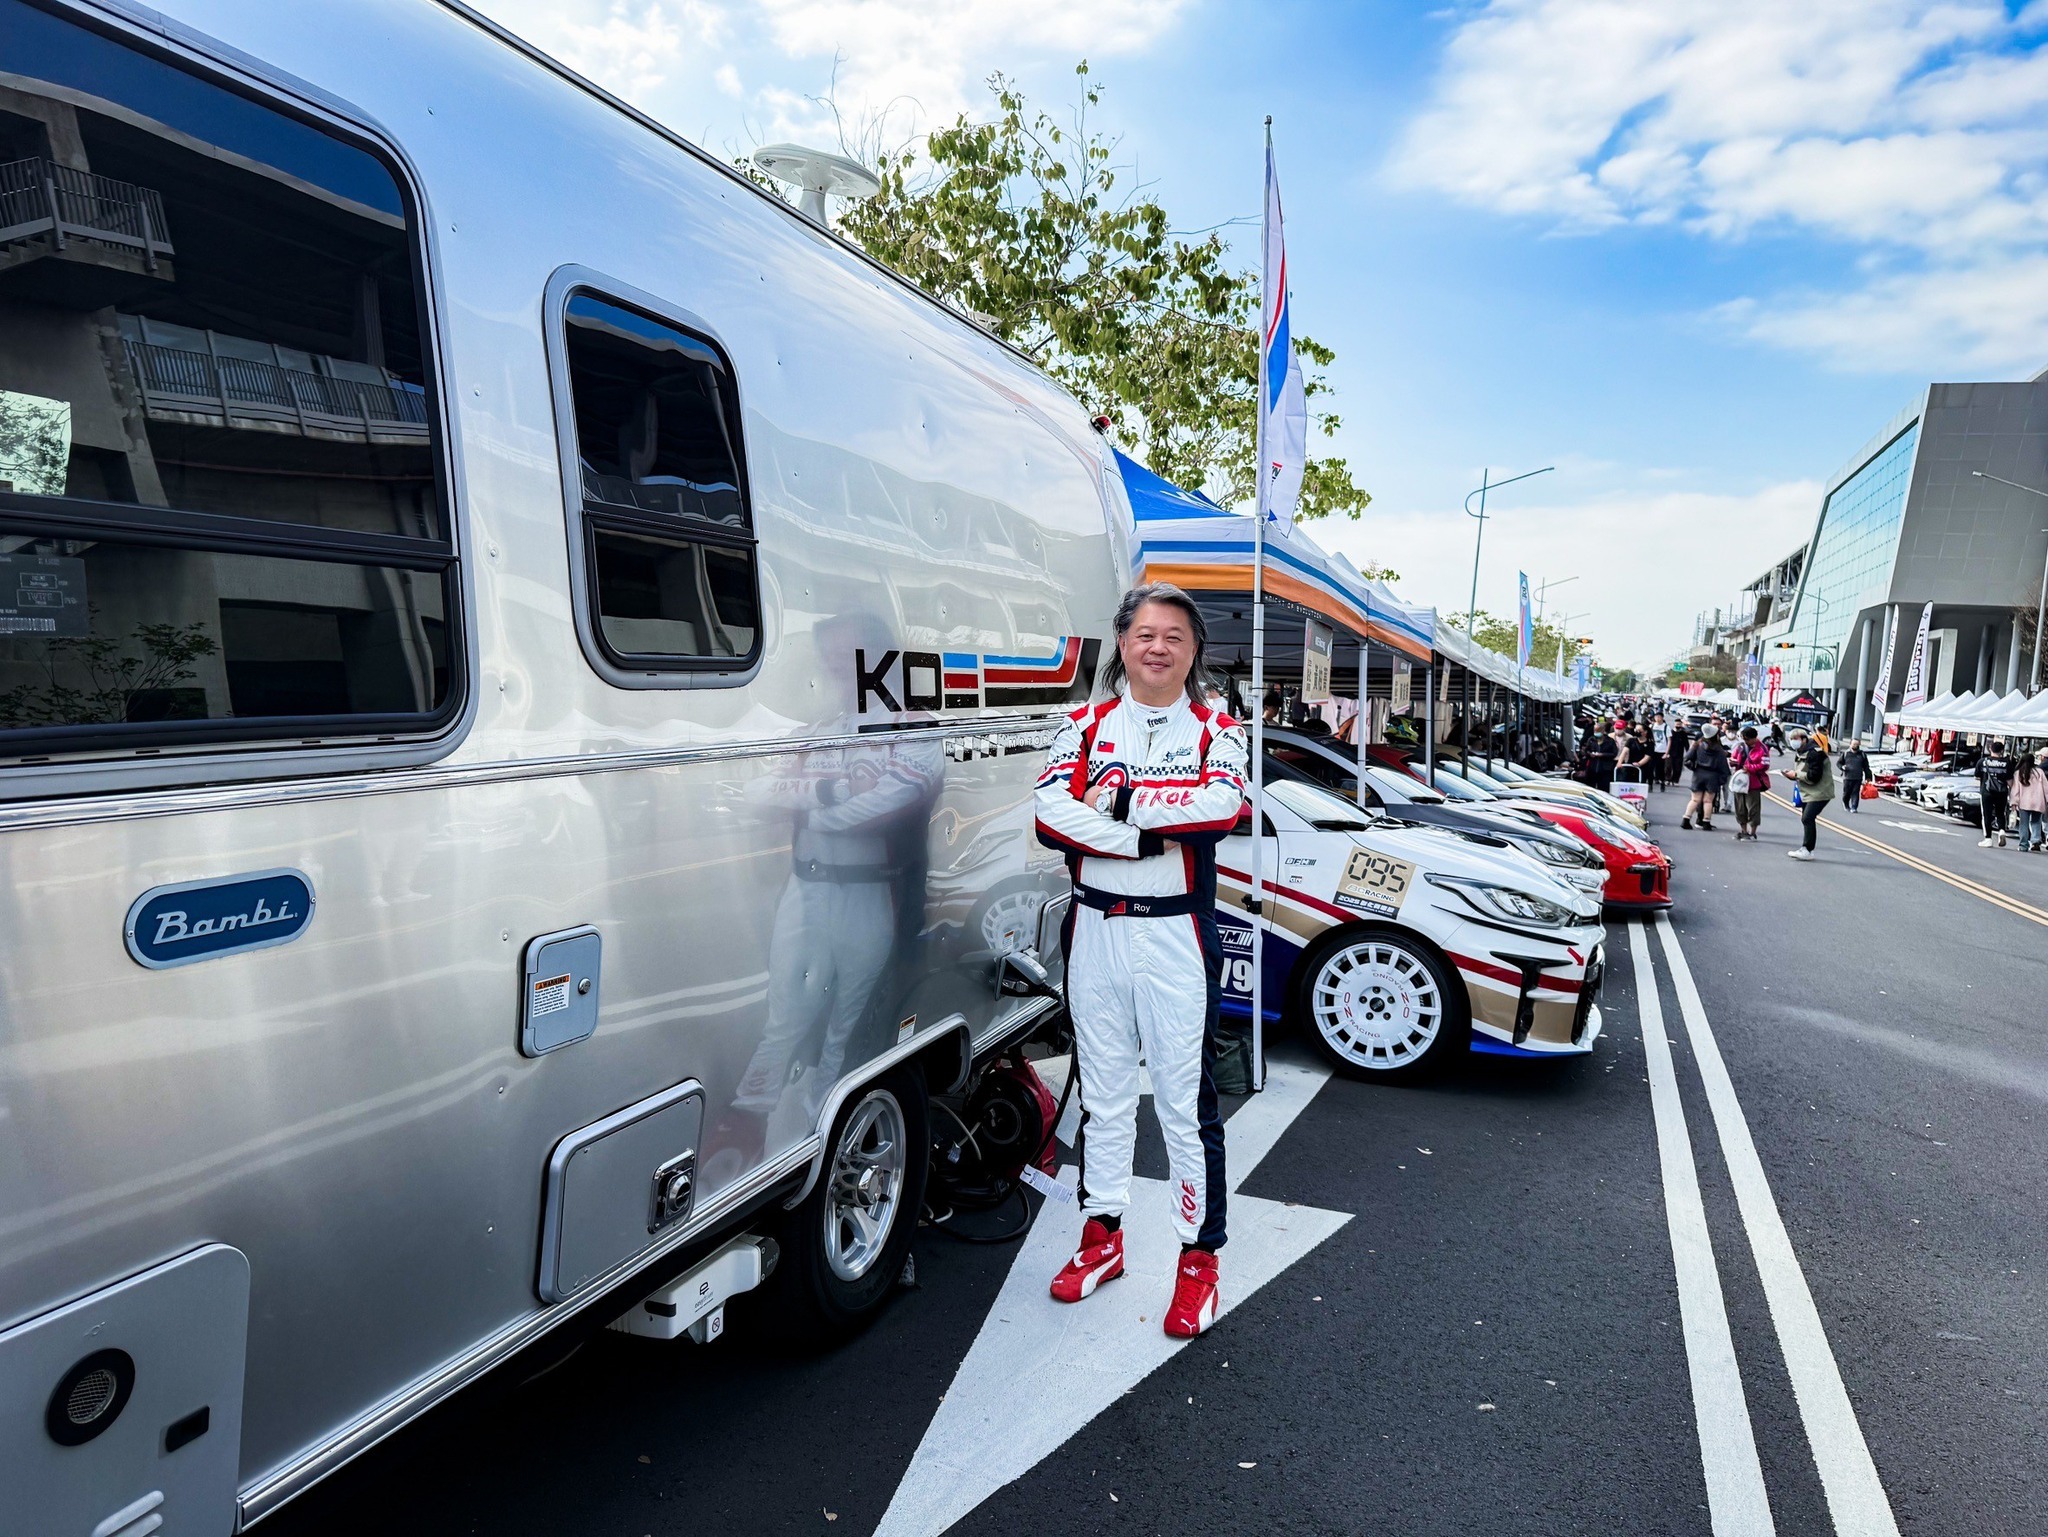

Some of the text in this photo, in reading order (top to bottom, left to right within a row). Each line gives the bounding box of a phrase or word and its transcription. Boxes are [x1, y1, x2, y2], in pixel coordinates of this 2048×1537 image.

[855, 648, 979, 714] KOE
[1348, 851, 1408, 893] 095
[153, 898, 293, 945] Bambi
[1133, 902, 1151, 914] Roy
